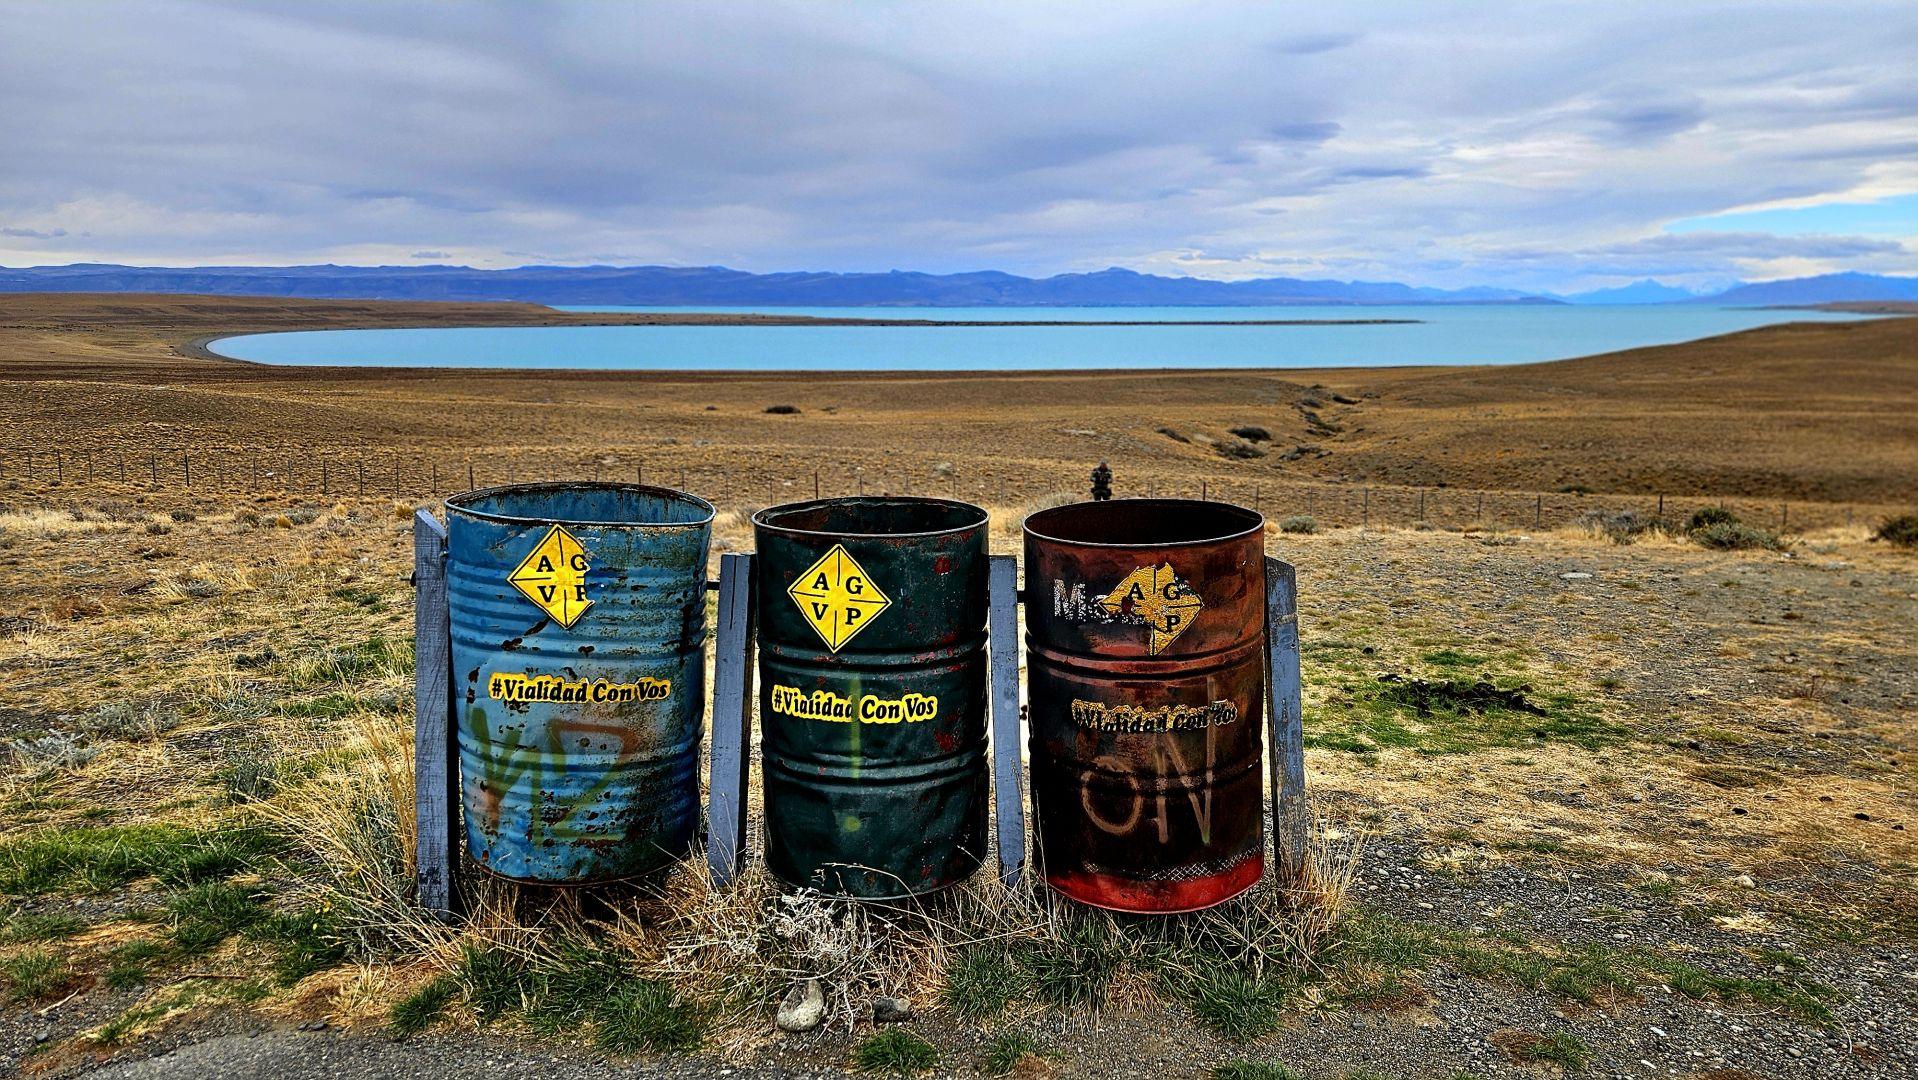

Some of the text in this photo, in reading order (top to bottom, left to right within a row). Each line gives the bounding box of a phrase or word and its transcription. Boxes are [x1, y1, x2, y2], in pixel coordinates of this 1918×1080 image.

[536, 554, 587, 572] A G
[812, 572, 863, 594] A G
[1126, 582, 1180, 601] A G
[537, 585, 556, 602] V
[811, 602, 861, 625] V P
[1165, 615, 1181, 633] P
[491, 678, 668, 702] #Vialidad Con Vos
[861, 699, 900, 719] Con
[905, 697, 934, 717] Vos
